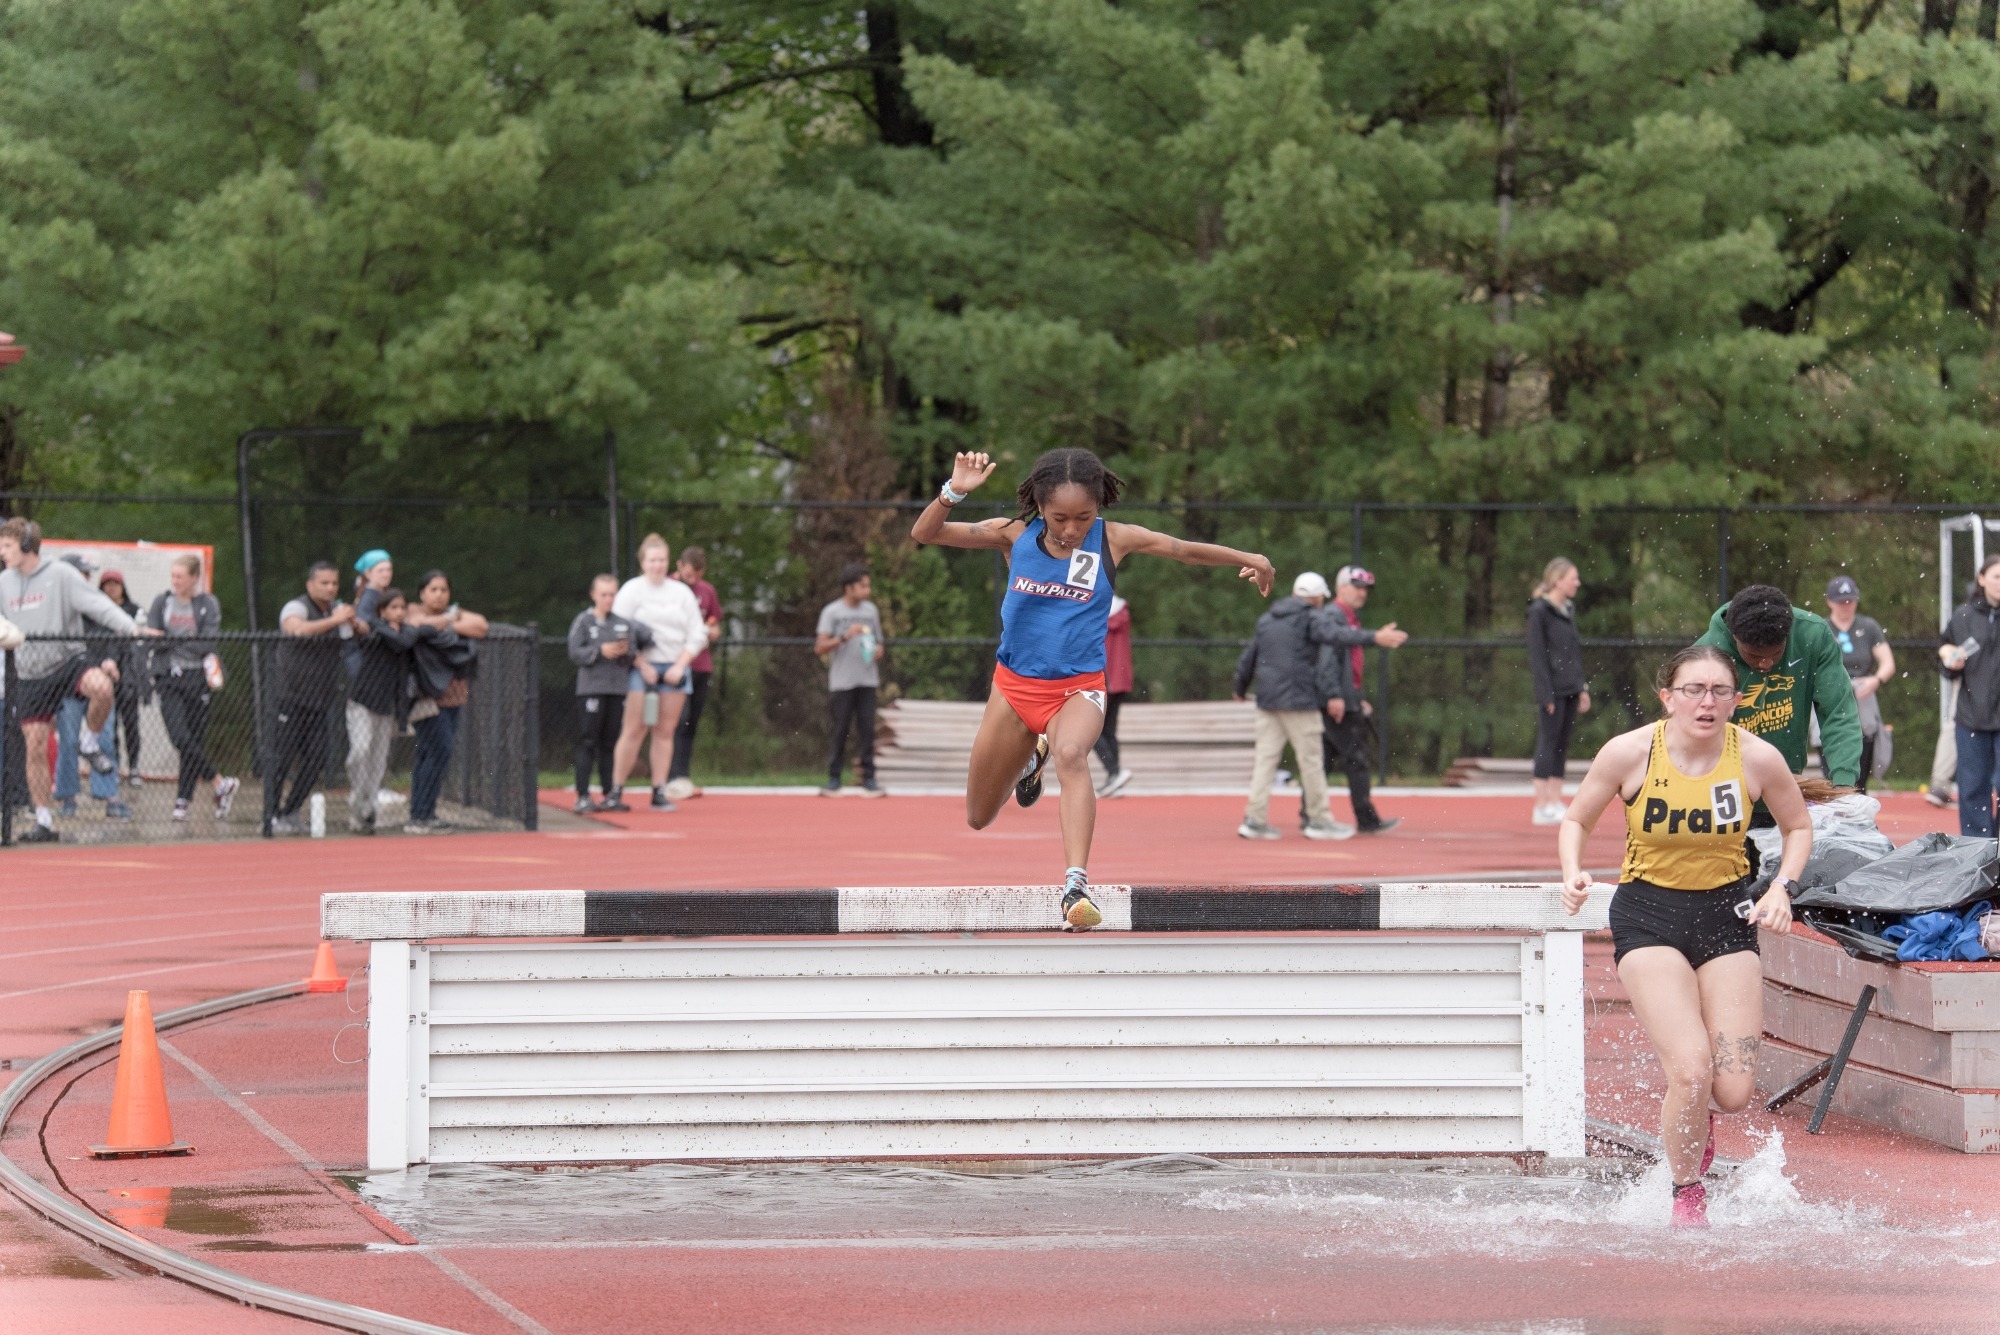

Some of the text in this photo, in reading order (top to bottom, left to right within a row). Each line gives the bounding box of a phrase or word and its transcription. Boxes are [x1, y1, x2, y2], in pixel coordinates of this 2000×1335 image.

[1072, 553, 1094, 586] 2
[1766, 697, 1792, 709] DELHI
[1760, 713, 1794, 728] COUNTRY
[1769, 721, 1788, 732] FIELD
[1714, 783, 1737, 820] 5
